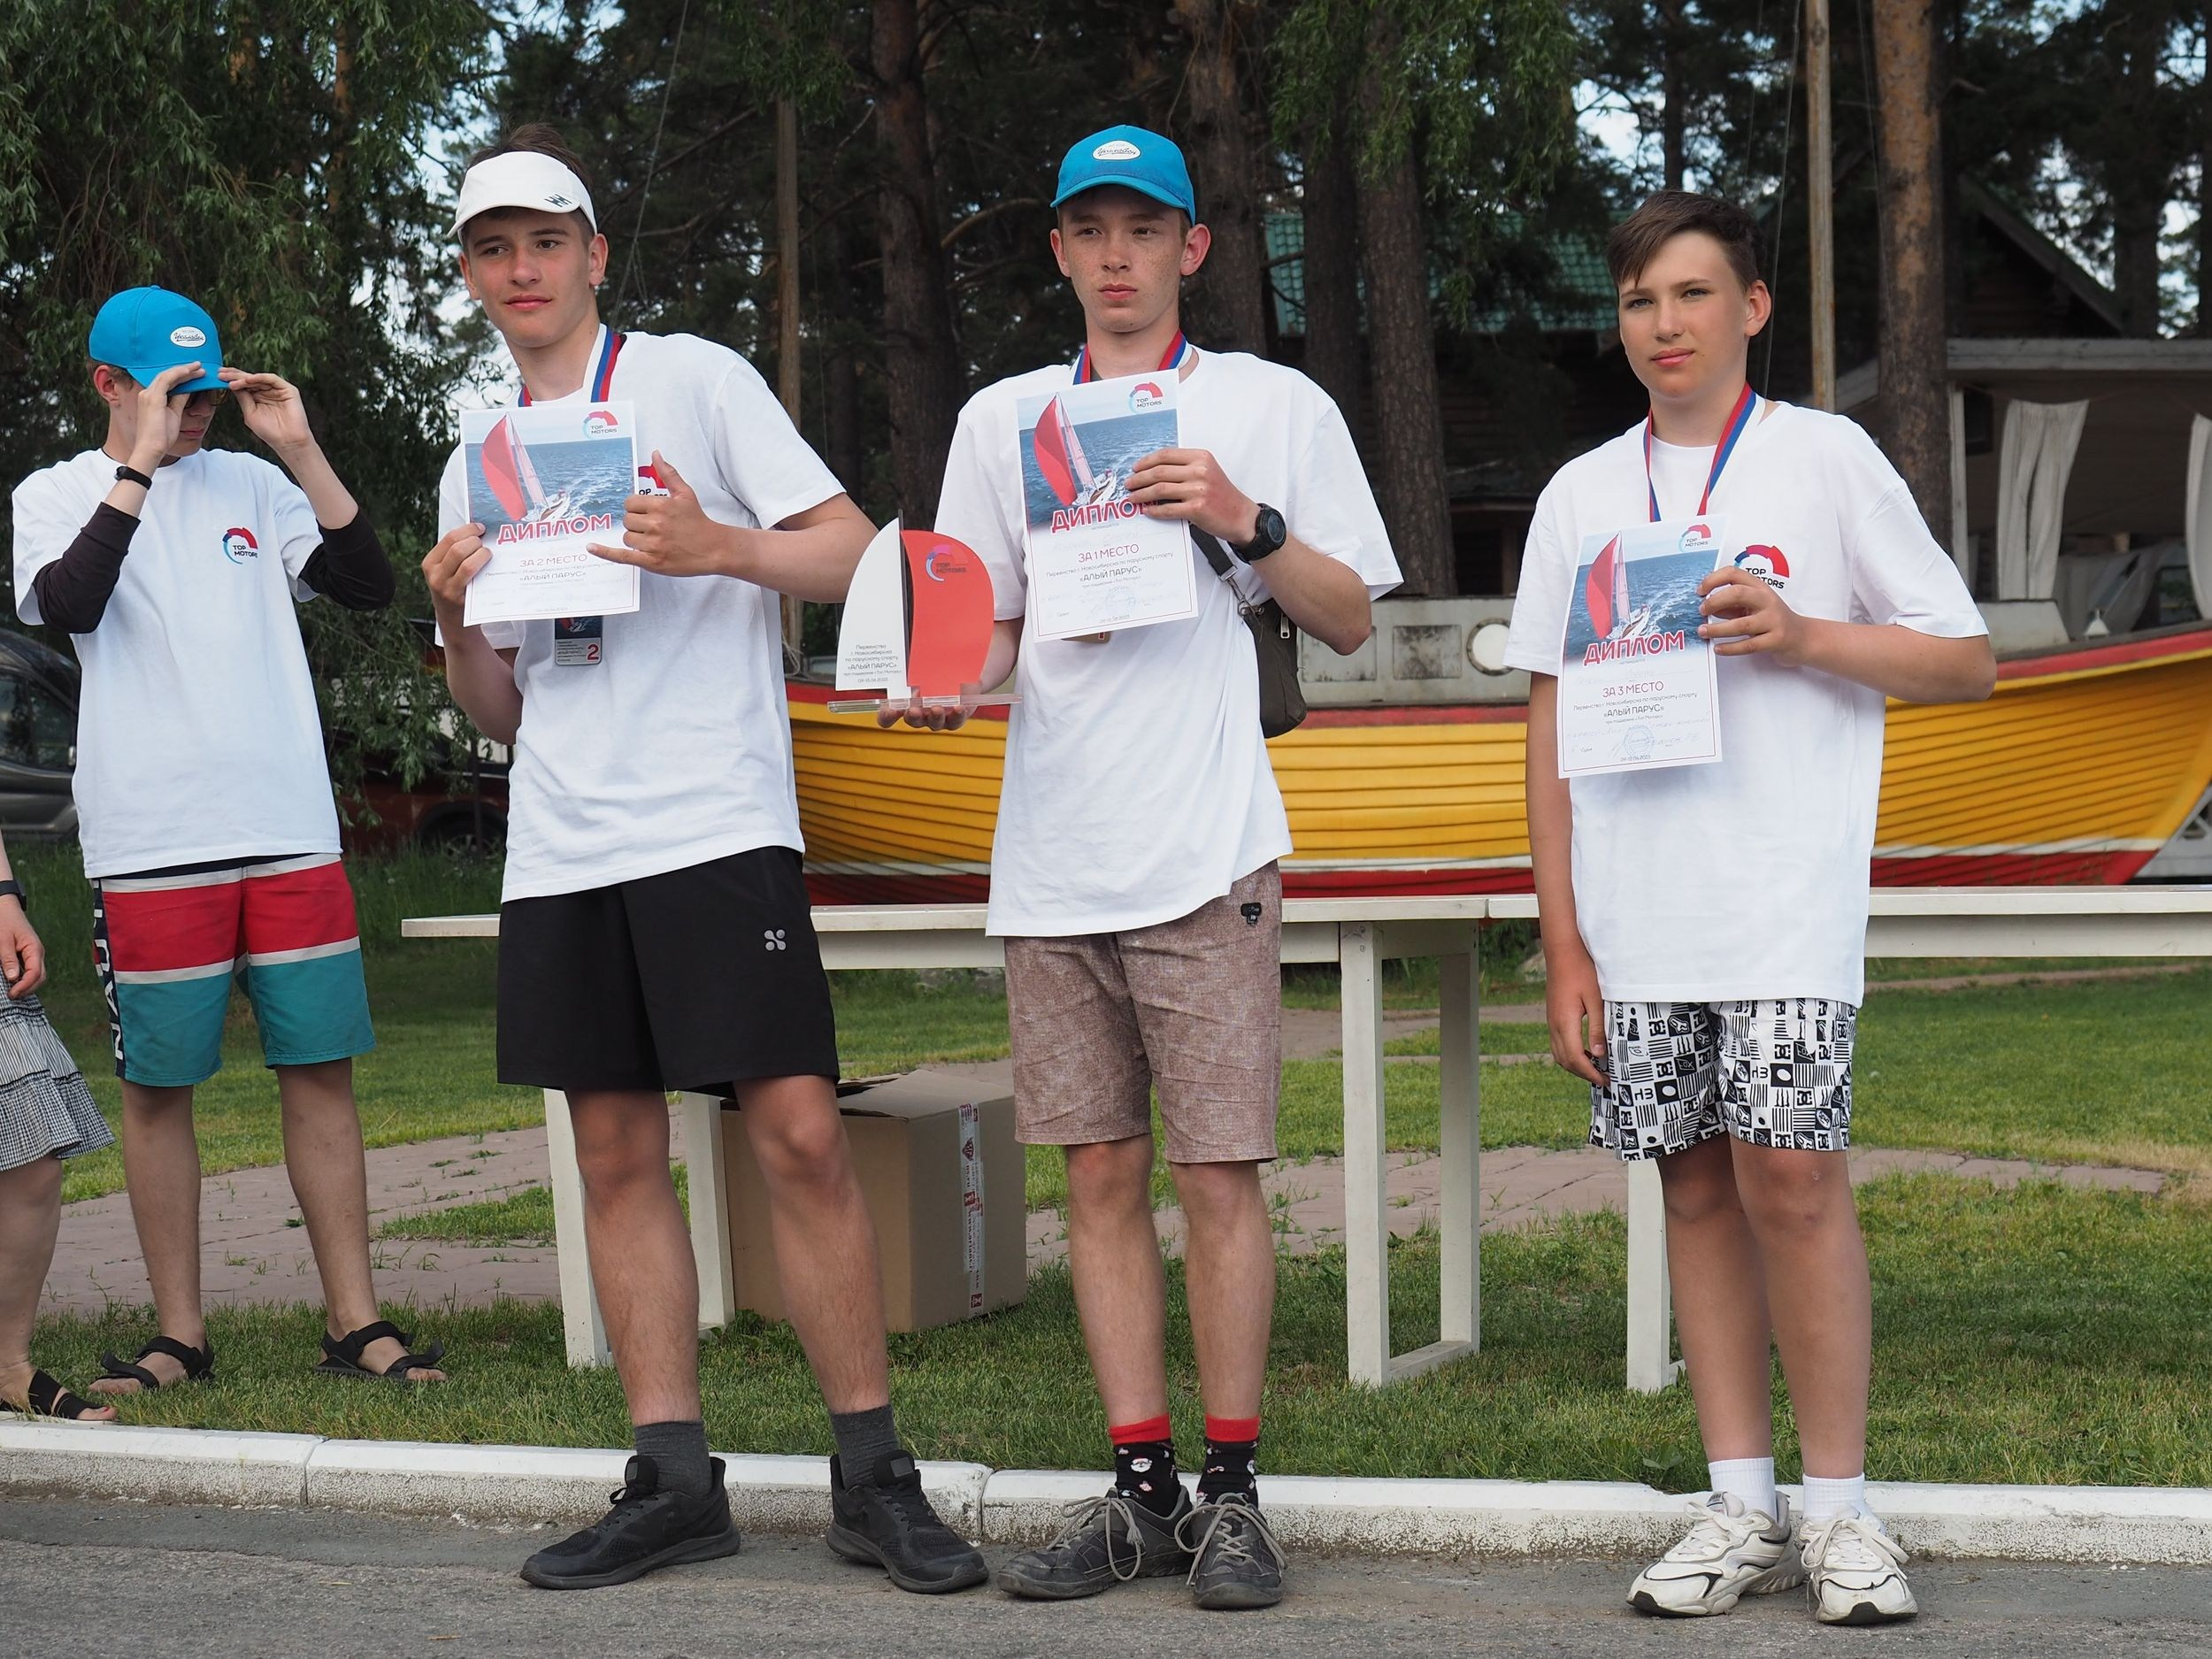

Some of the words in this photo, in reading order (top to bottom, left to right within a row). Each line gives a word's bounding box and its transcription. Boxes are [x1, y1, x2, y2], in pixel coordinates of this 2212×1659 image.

[1051, 496, 1157, 533] ДИПЛО
[496, 512, 611, 545] ДИПЛОМ
[519, 558, 534, 567] ЗА
[546, 554, 588, 565] МЕСТО
[1078, 552, 1093, 563] ЗА
[1094, 551, 1098, 560] 1
[1100, 544, 1139, 559] МЕСТО
[1757, 576, 1785, 589] TORS
[588, 643, 599, 660] 2
[1583, 630, 1685, 666] ДИПЛОМ
[1602, 687, 1616, 697] ЗА
[1617, 686, 1624, 695] 3
[1626, 680, 1663, 695] МЕСТО
